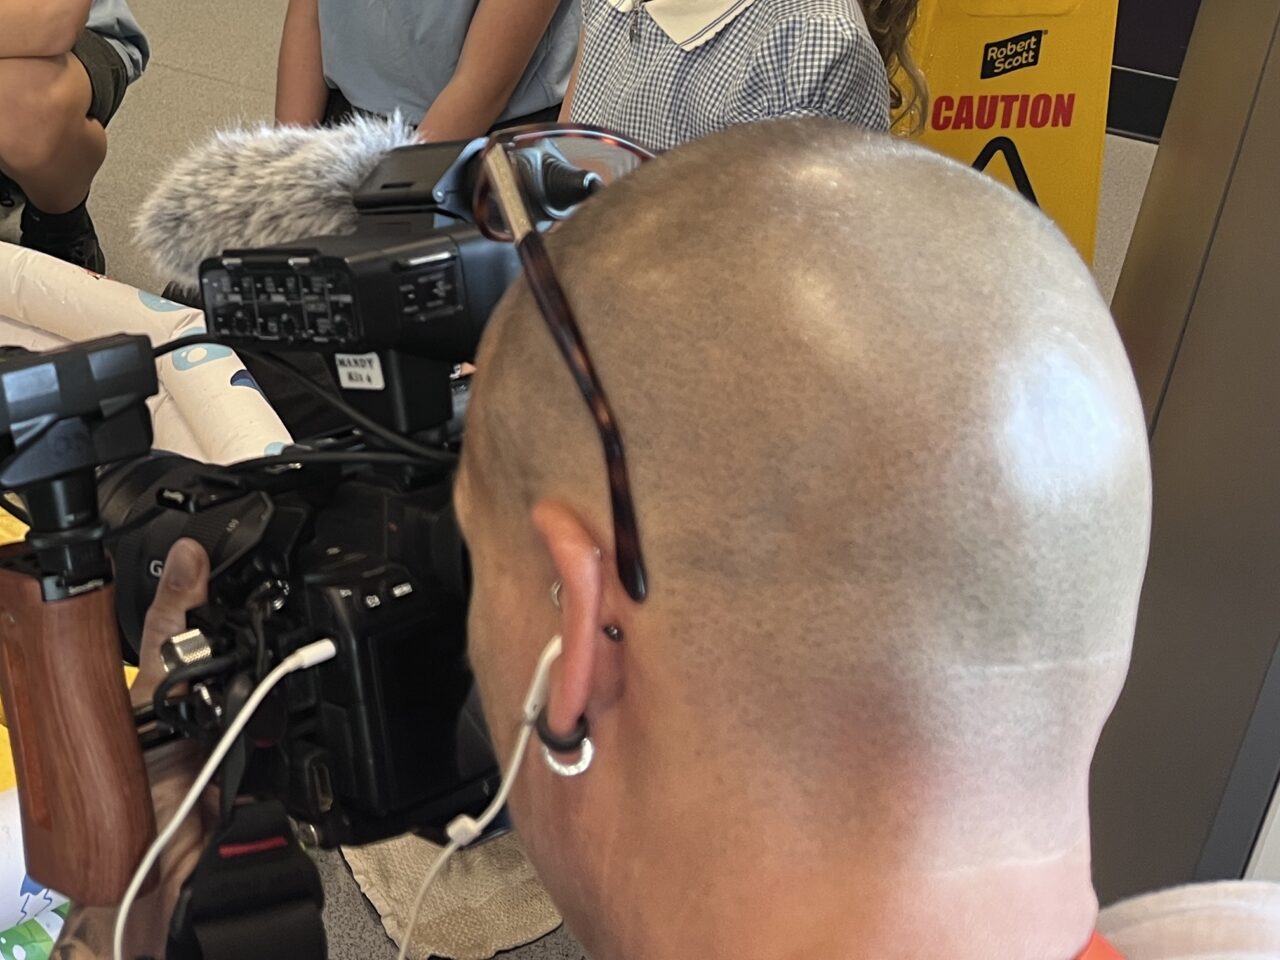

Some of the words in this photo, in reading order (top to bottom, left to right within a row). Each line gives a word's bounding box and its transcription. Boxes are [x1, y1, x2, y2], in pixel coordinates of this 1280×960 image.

[987, 36, 1038, 61] Robert
[994, 50, 1035, 73] Scott
[931, 93, 1076, 131] CAUTION
